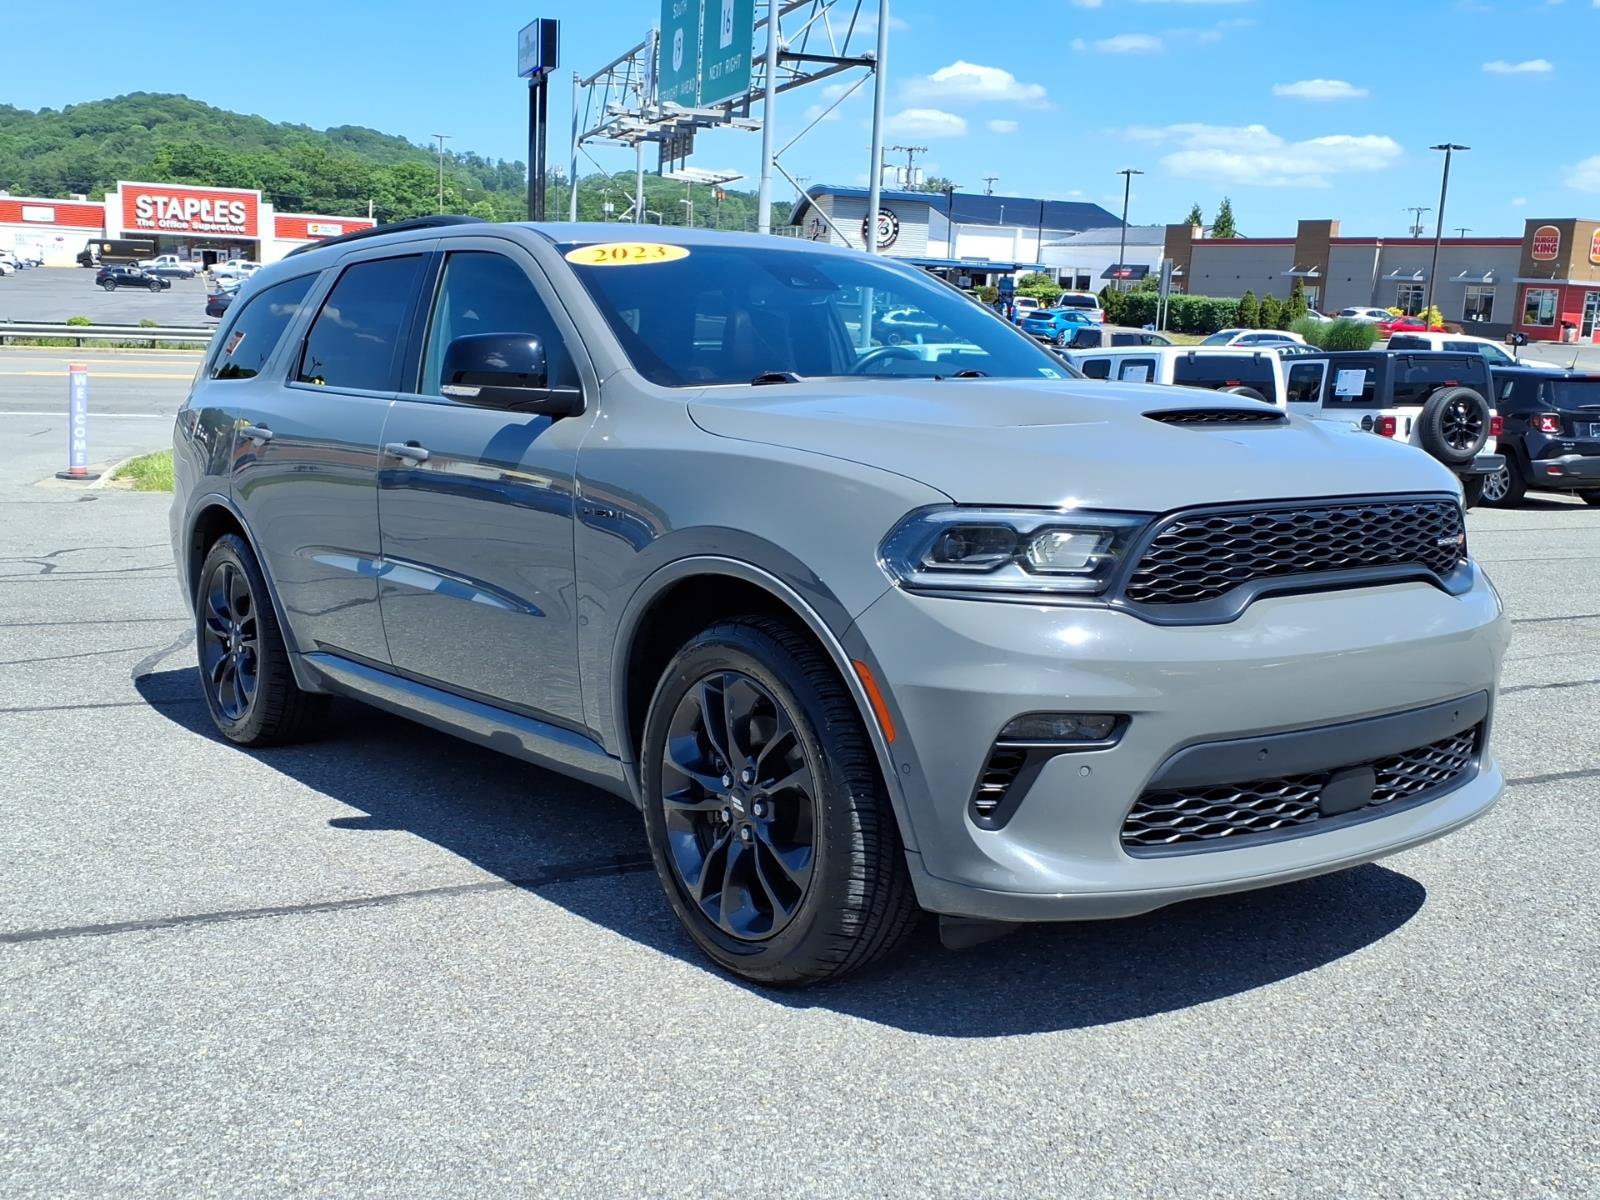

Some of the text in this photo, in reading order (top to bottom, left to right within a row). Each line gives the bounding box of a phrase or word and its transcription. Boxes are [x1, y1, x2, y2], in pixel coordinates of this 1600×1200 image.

[723, 7, 731, 35] 16
[135, 194, 246, 224] STAPLES
[136, 219, 246, 232] The Office Superstore
[593, 246, 666, 262] 2023
[1534, 244, 1558, 253] KING
[73, 374, 86, 463] WELCOME
